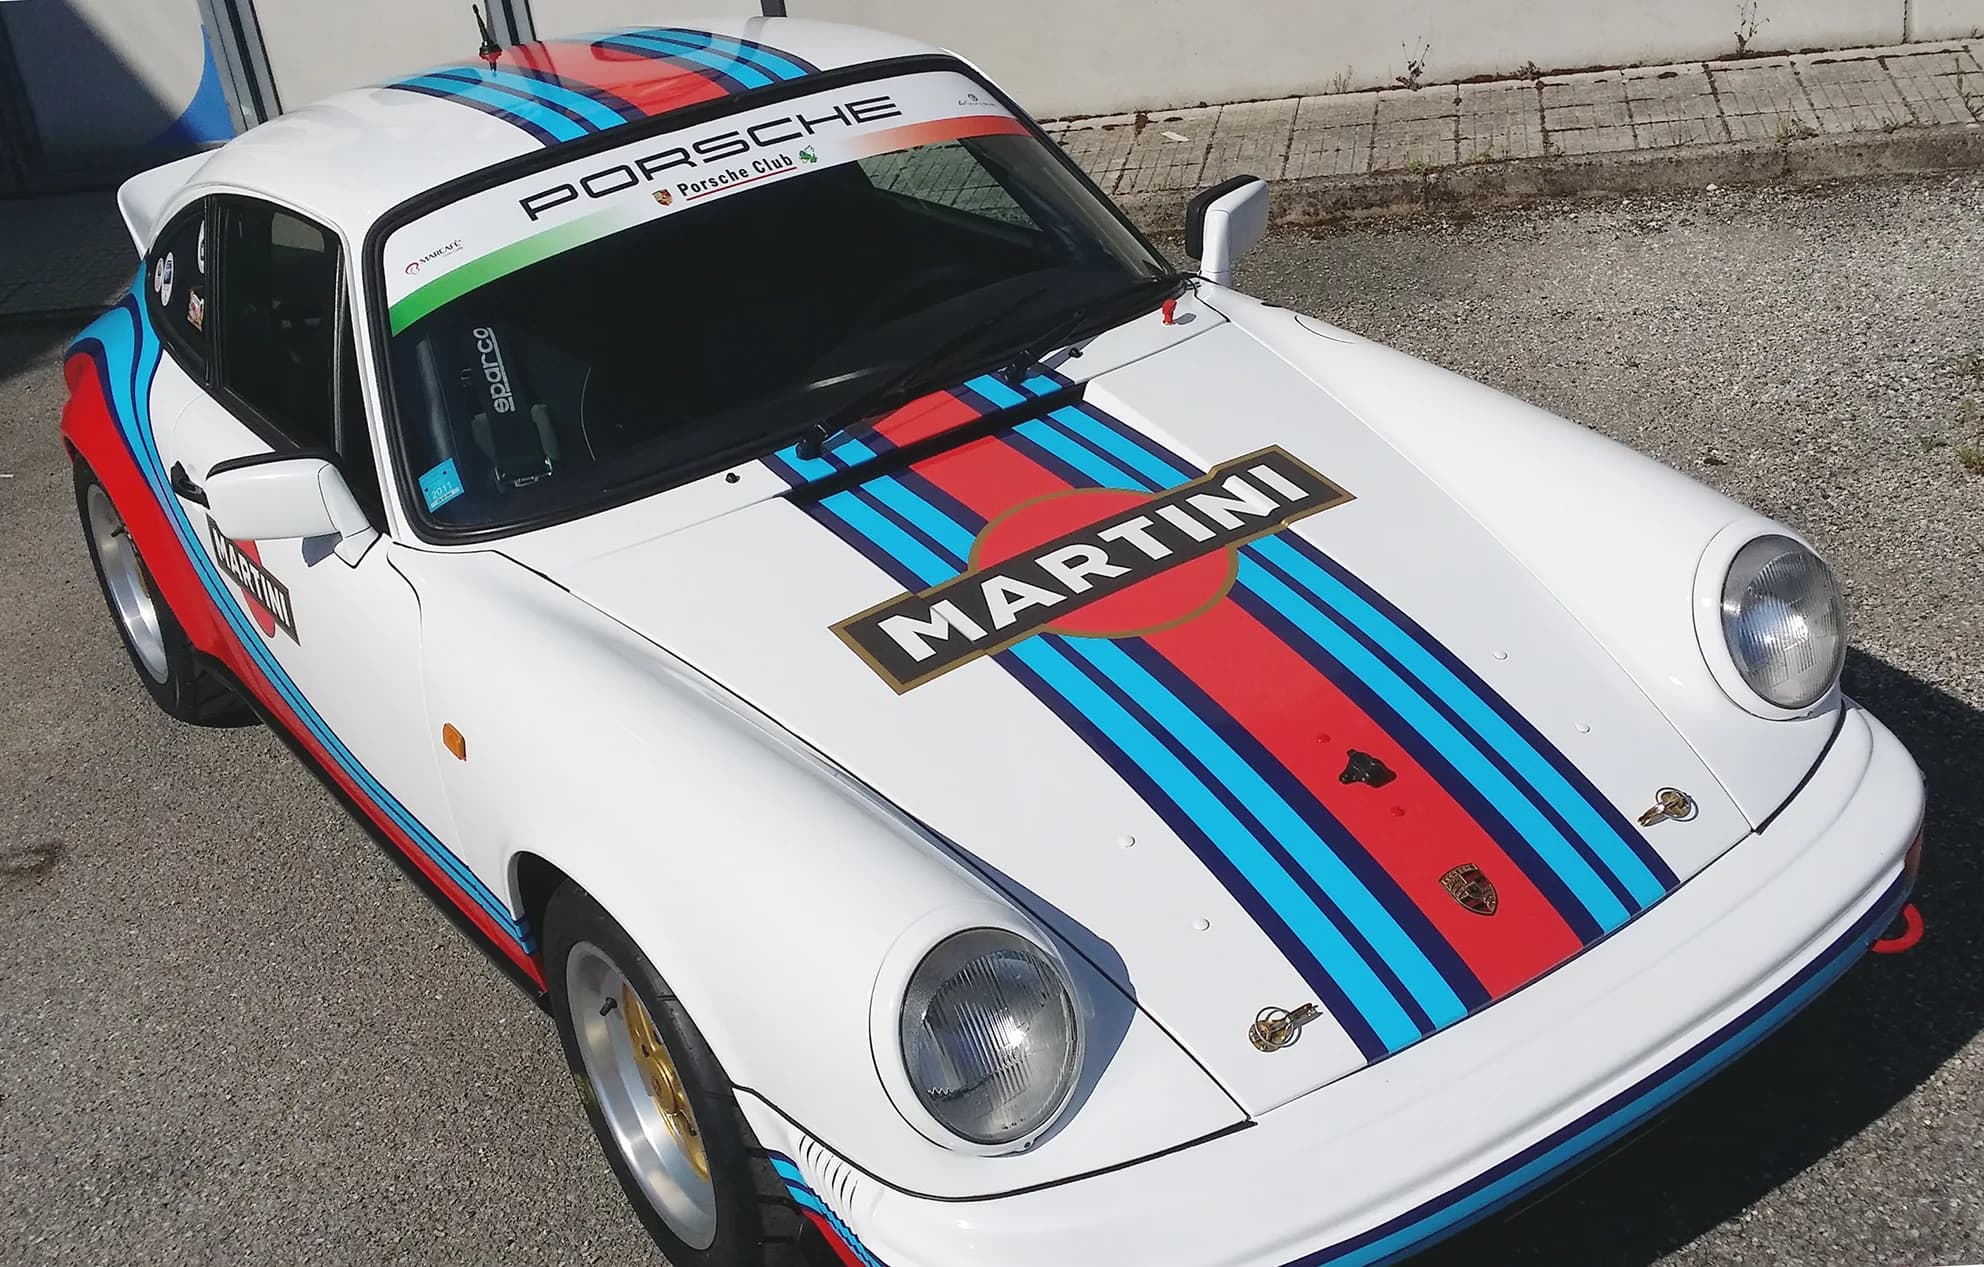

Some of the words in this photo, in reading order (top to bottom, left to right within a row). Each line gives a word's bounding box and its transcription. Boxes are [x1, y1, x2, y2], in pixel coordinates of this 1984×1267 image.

[519, 95, 903, 221] PORSCHE
[676, 169, 750, 197] Porsche
[752, 153, 793, 174] Club
[472, 327, 516, 414] sparco
[431, 481, 452, 499] 2011
[211, 526, 291, 628] MARTINI
[877, 464, 1310, 663] MARTINI
